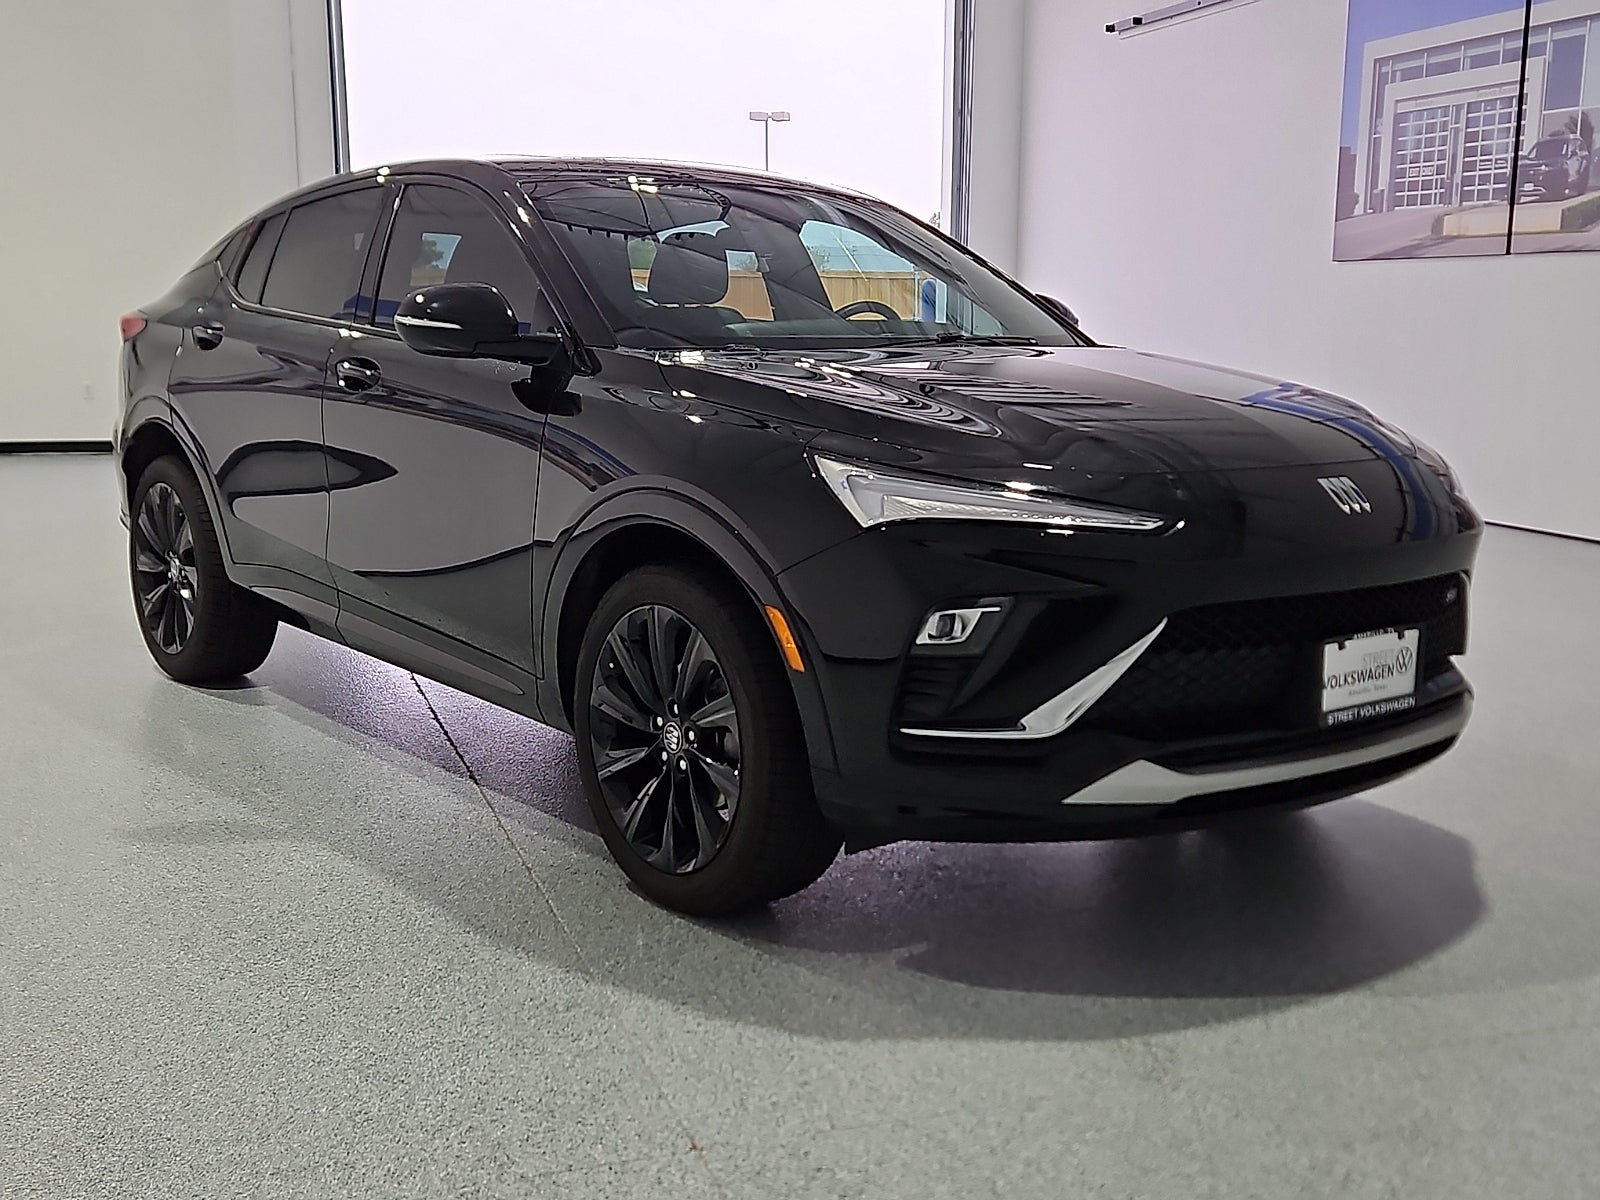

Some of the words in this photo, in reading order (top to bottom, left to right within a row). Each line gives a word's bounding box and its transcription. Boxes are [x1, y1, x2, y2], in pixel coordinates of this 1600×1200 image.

[1362, 648, 1394, 666] STREET
[1326, 664, 1395, 689] VOLKSWAGEN
[1328, 708, 1358, 725] STREET
[1360, 696, 1416, 717] VOLKSWAGEN
